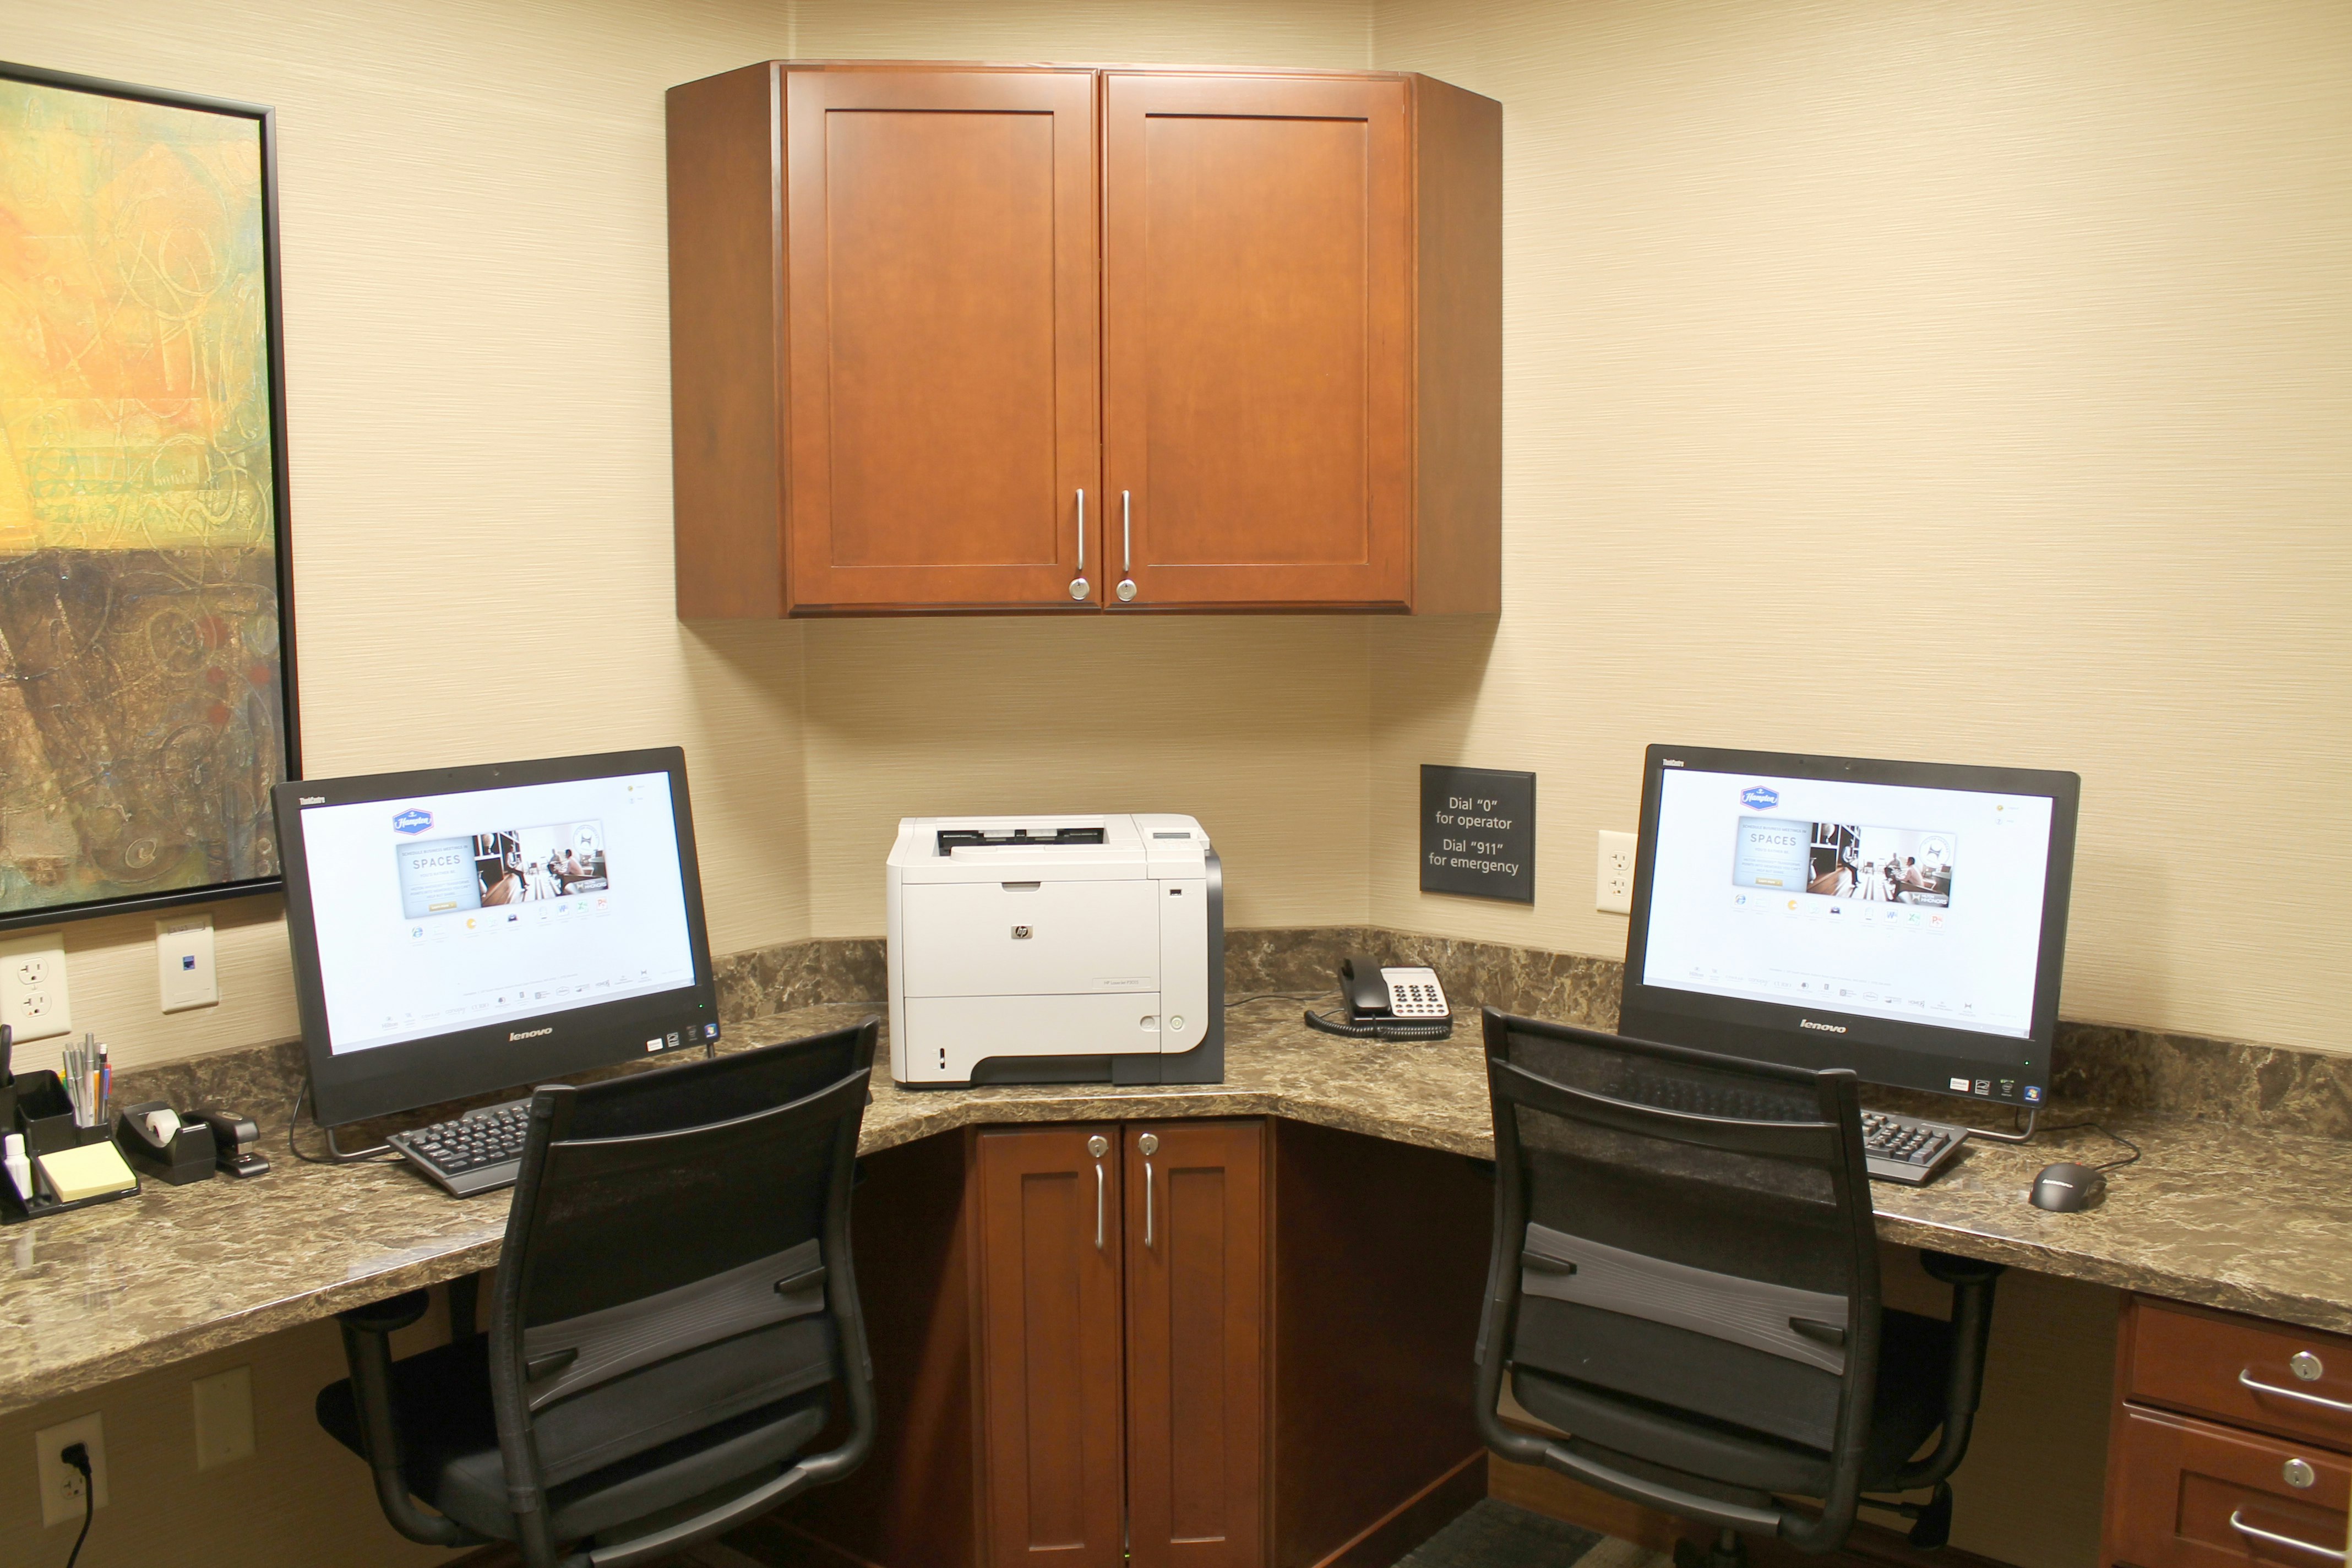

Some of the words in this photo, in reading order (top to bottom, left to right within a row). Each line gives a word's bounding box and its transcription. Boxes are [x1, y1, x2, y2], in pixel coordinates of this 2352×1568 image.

[1449, 797, 1472, 810] Dial
[1743, 793, 1777, 803] Hampton
[395, 817, 432, 829] Hampton
[1435, 811, 1454, 824] for
[1457, 816, 1512, 830] operator
[1443, 839, 1466, 852] Dial
[1750, 833, 1797, 846] SPACES
[412, 854, 461, 870] SPACES
[1429, 852, 1447, 865] for
[1451, 858, 1519, 876] emergency
[1800, 1019, 1846, 1033] lenovo
[509, 1027, 553, 1042] lenovo
[2042, 1179, 2073, 1188] lenovo
